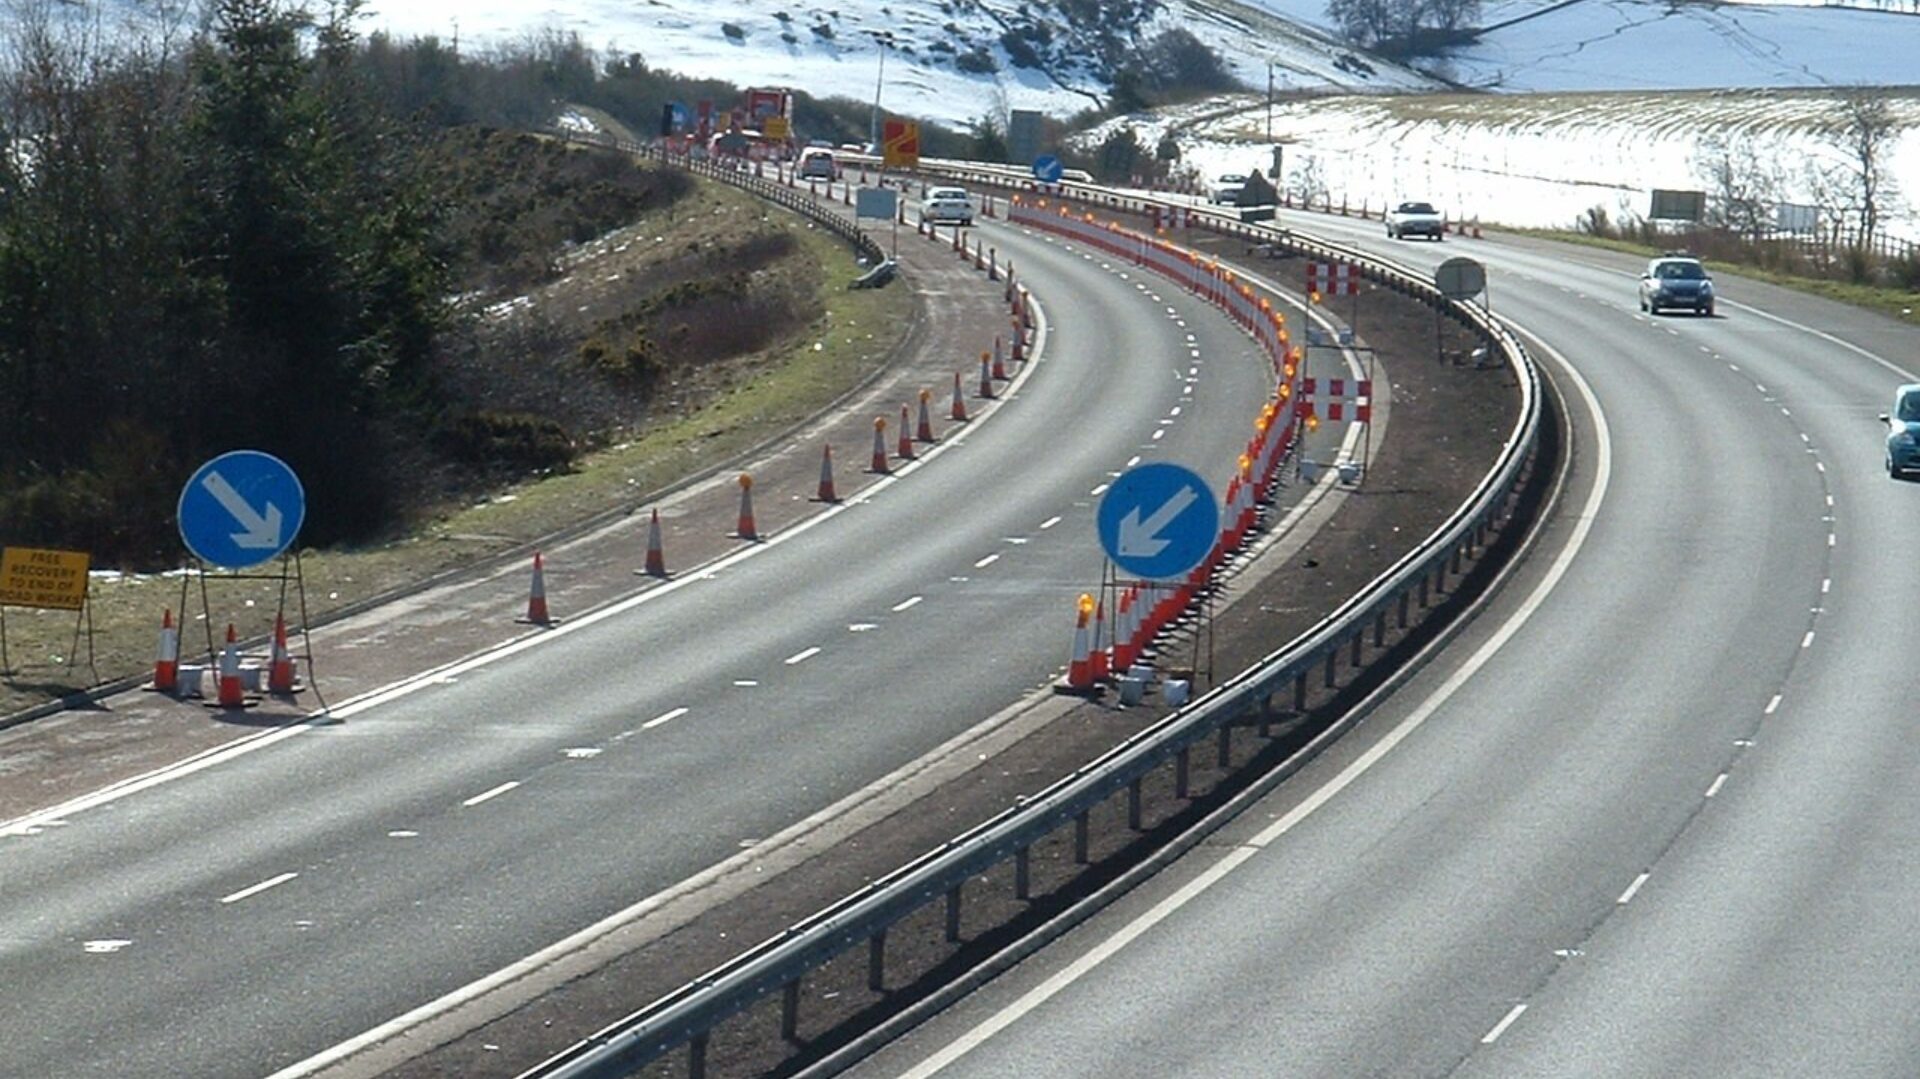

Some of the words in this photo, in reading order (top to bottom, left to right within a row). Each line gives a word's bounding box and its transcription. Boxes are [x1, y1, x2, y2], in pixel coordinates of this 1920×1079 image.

[11, 564, 77, 578] RECOVERY
[10, 576, 25, 588] TO
[28, 579, 55, 590] END
